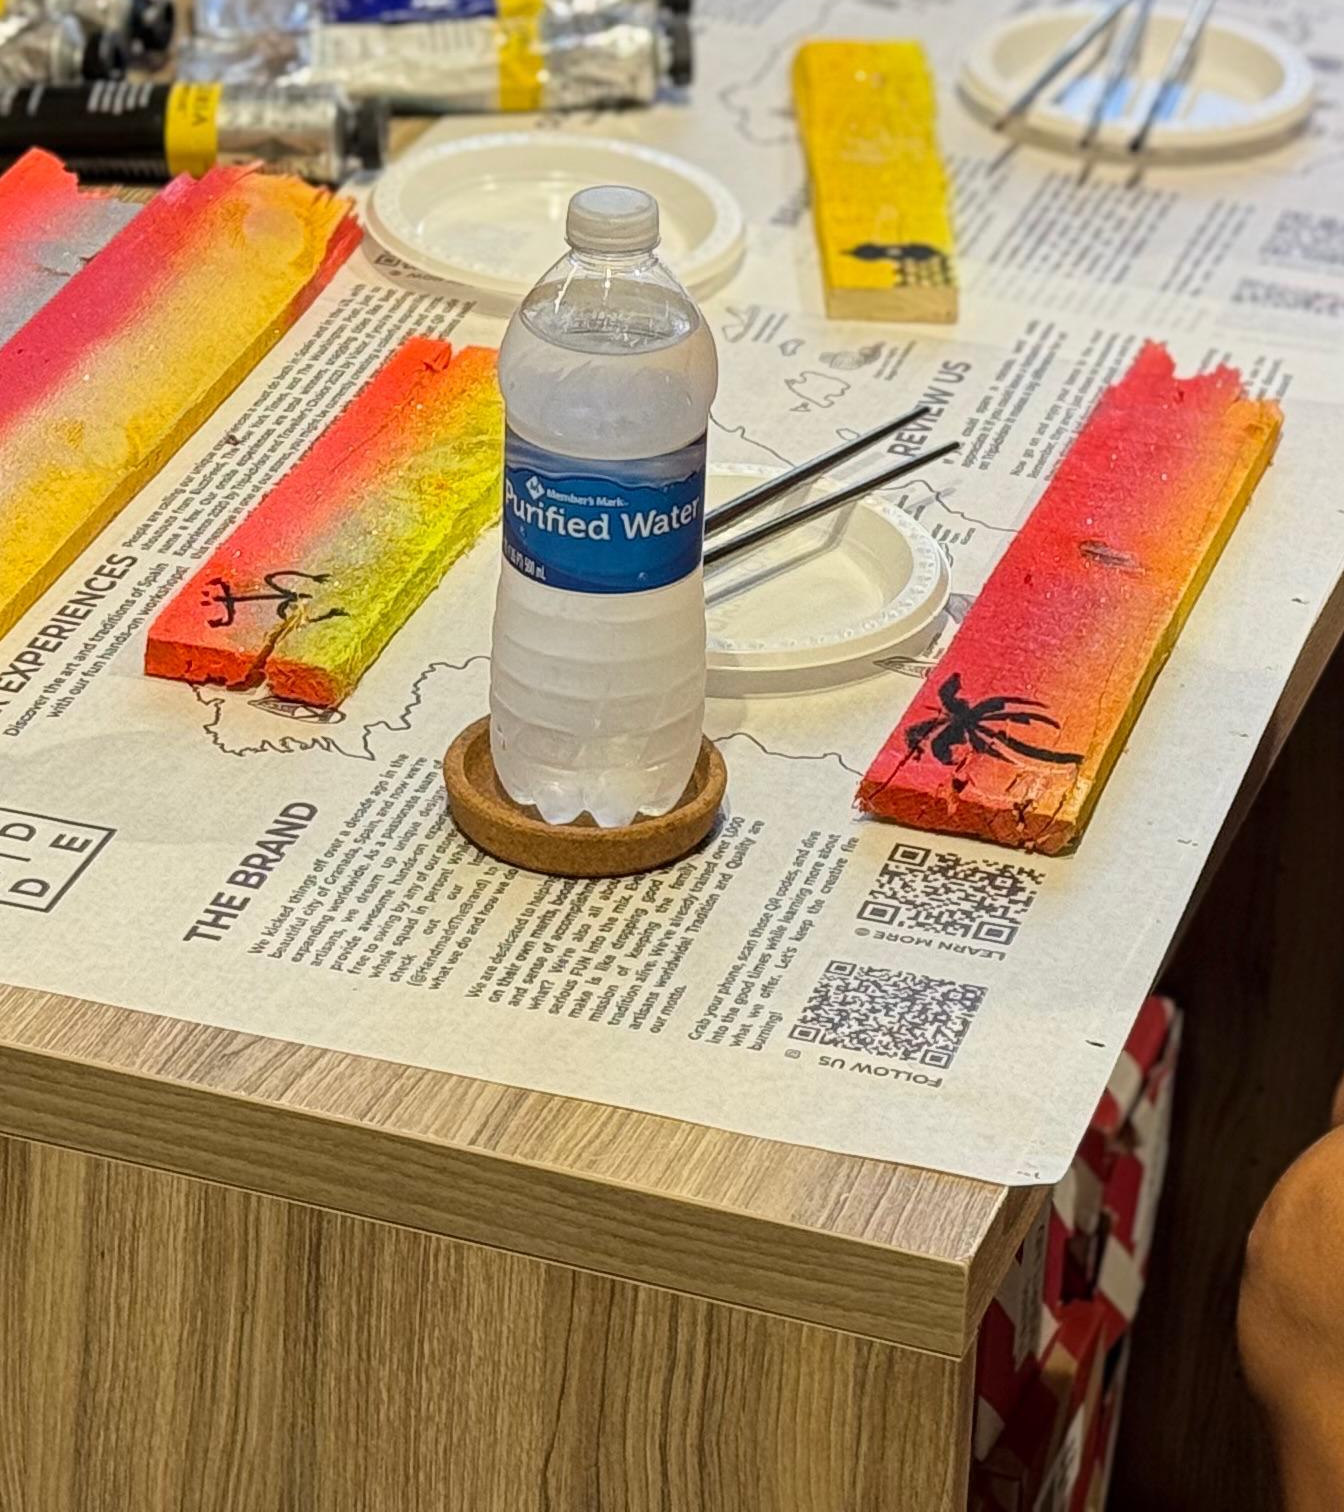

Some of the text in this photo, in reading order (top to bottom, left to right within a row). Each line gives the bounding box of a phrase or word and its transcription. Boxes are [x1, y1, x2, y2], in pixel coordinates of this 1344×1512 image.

[887, 386, 955, 457] REVIEW
[940, 360, 972, 384] US
[505, 478, 700, 540] Purified Water
[547, 489, 594, 506] Member's
[2, 694, 51, 737] Discover
[42, 677, 67, 694] the
[59, 662, 81, 677] art
[73, 642, 98, 662] and
[88, 598, 137, 642] traditions
[136, 563, 169, 588] Spain
[46, 696, 75, 718] with
[68, 677, 90, 696] our
[80, 660, 107, 678] fun
[95, 617, 145, 660] hands-on
[182, 802, 318, 942] THE BRAND
[260, 905, 296, 937] kicked
[287, 874, 318, 904] things
[313, 858, 330, 873] off
[323, 838, 345, 858] over
[343, 798, 376, 829] decade
[369, 780, 389, 796] ago
[389, 754, 410, 768] the
[267, 916, 310, 959] beautiful
[301, 899, 325, 916] city
[376, 799, 395, 817] and
[389, 780, 410, 800] now
[291, 914, 336, 963] expanding
[380, 795, 422, 840] passionate
[413, 771, 438, 793] team
[354, 874, 385, 904] dream
[392, 821, 423, 852] unique
[792, 848, 811, 867] and
[801, 831, 822, 849] dive
[329, 843, 429, 972] provide awesome hands-on
[346, 955, 371, 975] free
[373, 914, 402, 942] swing
[402, 882, 424, 900] any
[424, 854, 442, 872] our
[368, 950, 398, 978] whole
[392, 917, 420, 947] squad
[389, 884, 464, 982] check out our
[428, 966, 454, 990] what
[466, 916, 486, 936] and
[476, 895, 499, 916] how
[567, 990, 594, 1019] make
[593, 954, 617, 972] like
[610, 907, 649, 950] dropping
[640, 878, 665, 904] good
[571, 923, 592, 943] also
[587, 905, 604, 918] all
[588, 984, 620, 1022] mission
[623, 921, 662, 959] keeping
[654, 897, 675, 914] the
[667, 863, 698, 890] family
[607, 984, 643, 1026] tradition
[668, 893, 700, 928] already
[688, 860, 719, 893] trained
[711, 840, 731, 860] over
[628, 991, 661, 1030] artisans
[684, 893, 721, 933] Tradition
[713, 872, 734, 891] and
[724, 837, 757, 870] Quality
[748, 820, 765, 835] are
[704, 834, 842, 1044] into the good times while learning more about
[728, 1023, 754, 1047] what
[788, 919, 816, 942] keep
[806, 899, 825, 915] the
[820, 858, 848, 894] creative
[840, 837, 860, 853] fire
[737, 939, 759, 962] scan
[873, 930, 1007, 962] LEARN MORE
[479, 965, 498, 982] are
[495, 963, 522, 987] their
[515, 940, 538, 962] own
[507, 986, 529, 1007] and
[522, 956, 549, 985] sense
[548, 979, 579, 1015] serious
[569, 955, 594, 977] FUN
[582, 935, 607, 955] into
[598, 916, 619, 933] the
[703, 995, 724, 1018] your
[649, 1016, 668, 1034] our
[687, 1018, 712, 1040] Grab
[818, 1055, 943, 1088] FOLLOW US
